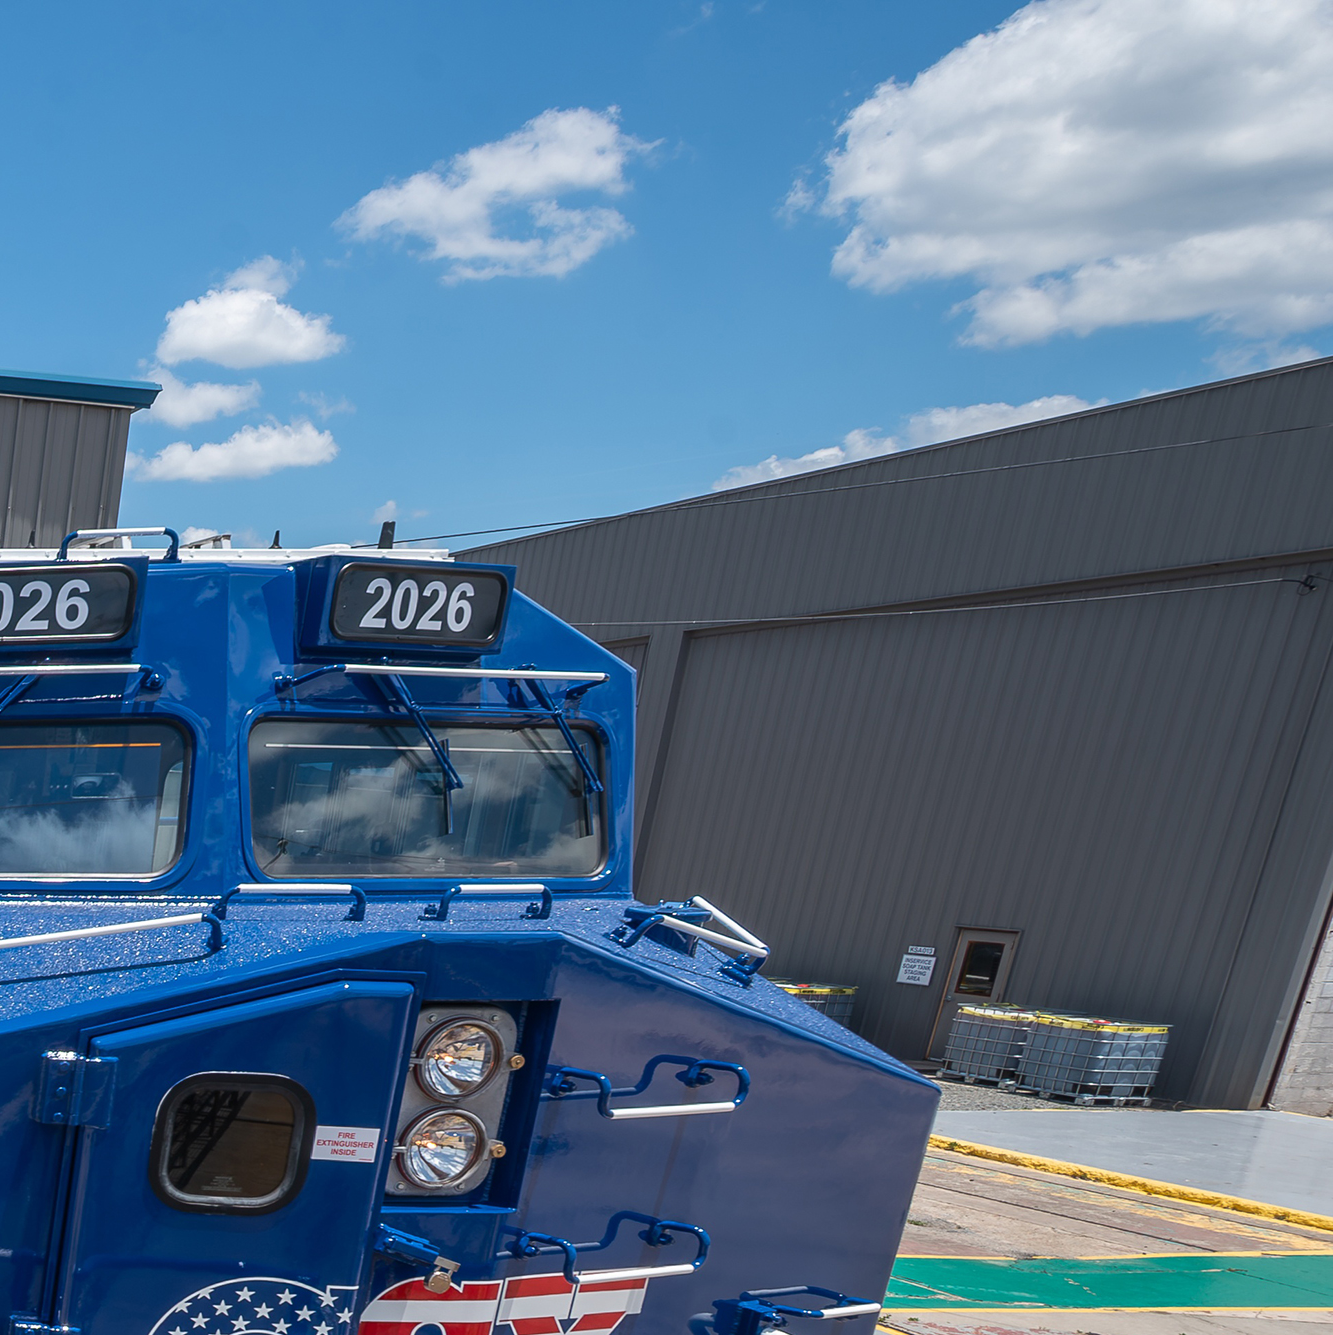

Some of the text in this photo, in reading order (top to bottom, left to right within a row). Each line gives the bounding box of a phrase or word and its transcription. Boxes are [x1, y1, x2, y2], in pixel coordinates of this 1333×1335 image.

[359, 577, 475, 633] 2026
[905, 957, 932, 965] INSERVICE
[904, 969, 927, 977] STAGING
[337, 1131, 356, 1140] FIRE
[316, 1139, 375, 1149] EXTINGUISHER
[330, 1148, 357, 1156] INSIDE
